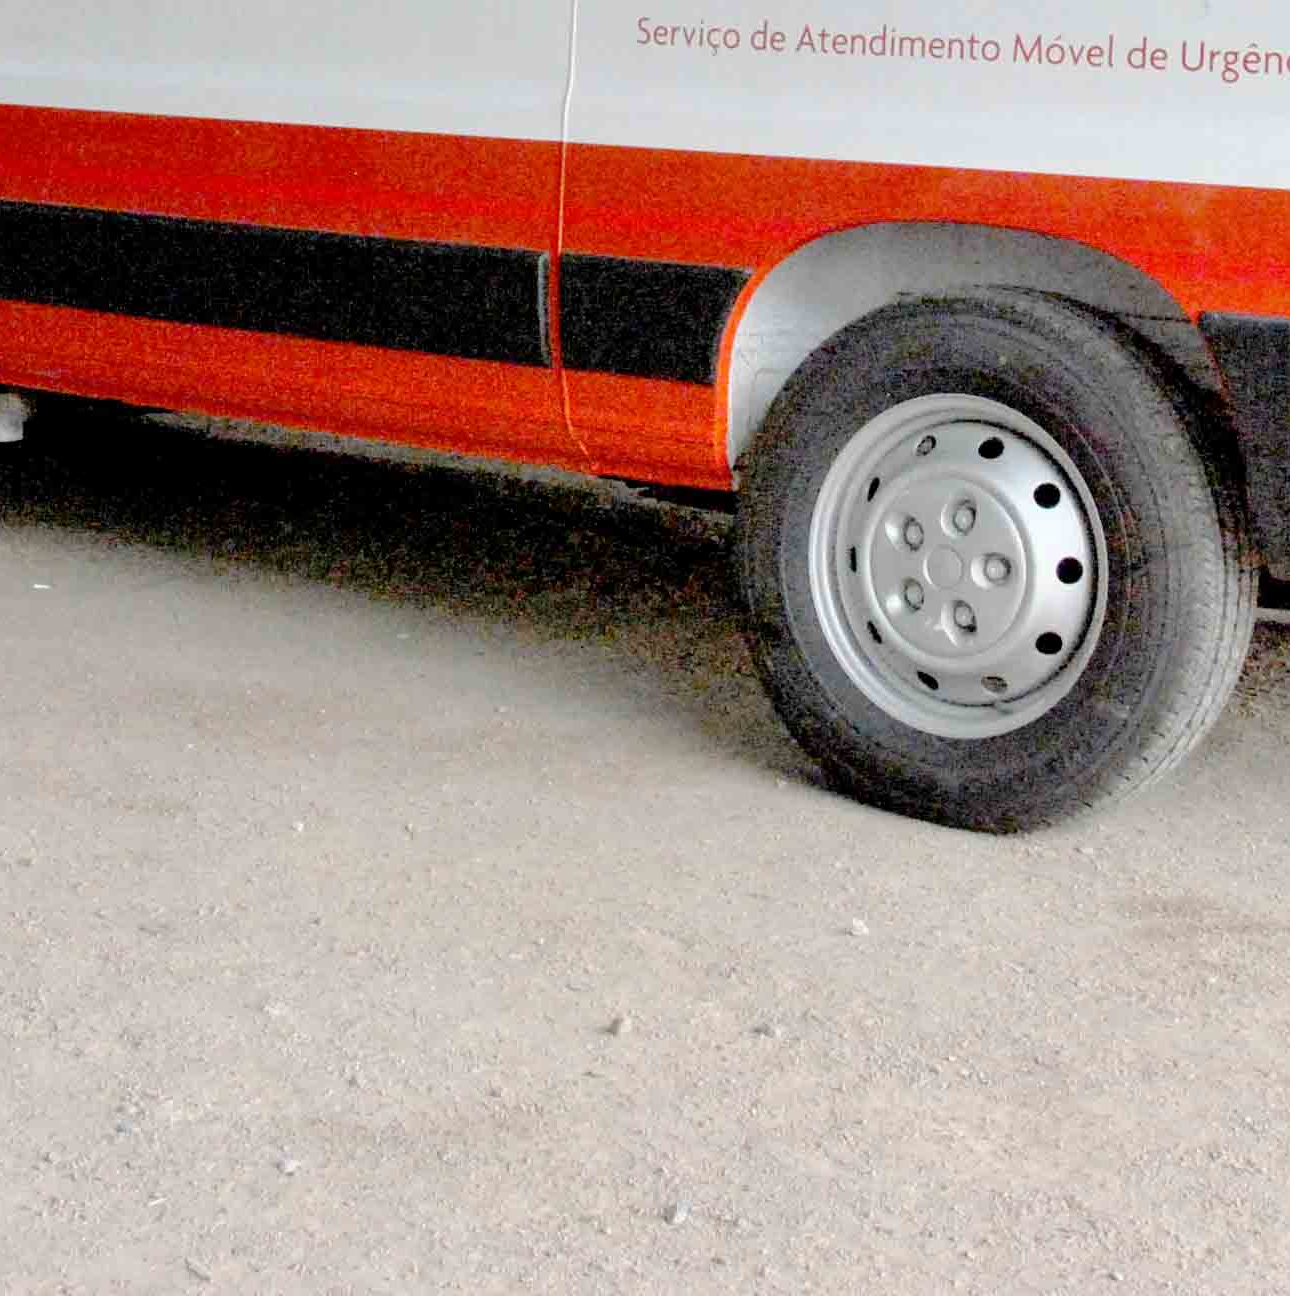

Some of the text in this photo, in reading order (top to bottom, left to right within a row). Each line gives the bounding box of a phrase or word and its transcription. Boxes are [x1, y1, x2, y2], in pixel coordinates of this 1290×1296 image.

[635, 16, 741, 57] Serviço
[749, 20, 788, 53] de
[796, 23, 1002, 65] Atendimento
[1011, 30, 1116, 70] Móvel
[1126, 34, 1170, 72] de
